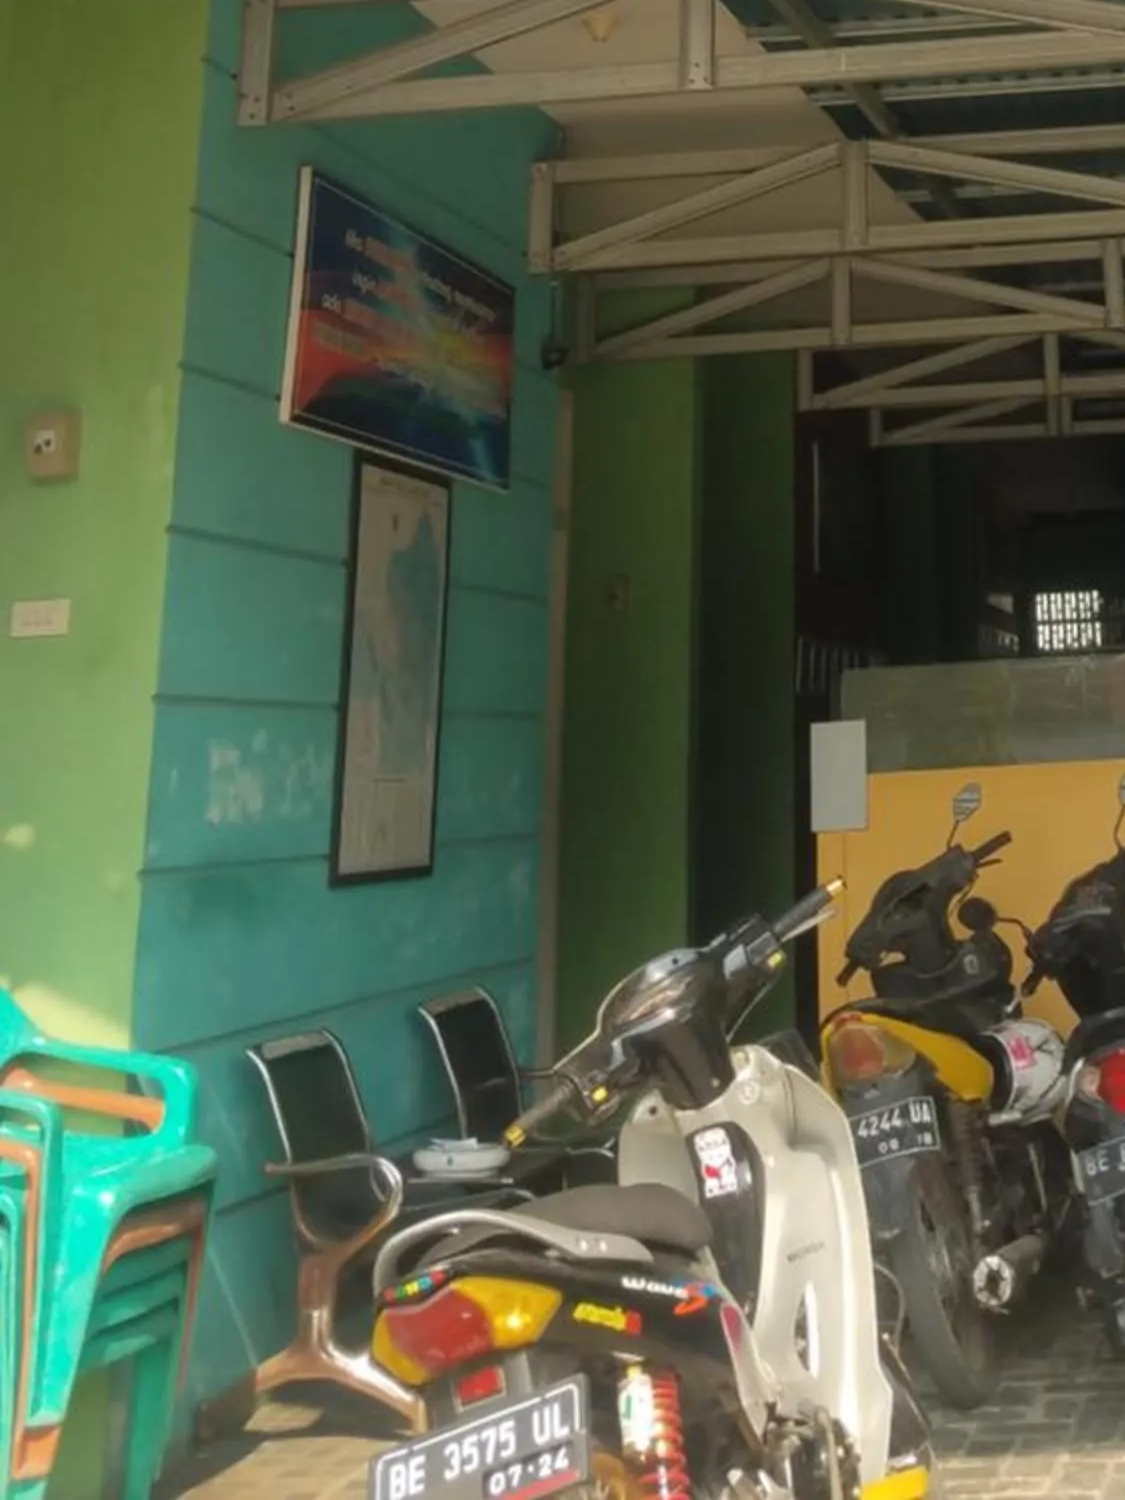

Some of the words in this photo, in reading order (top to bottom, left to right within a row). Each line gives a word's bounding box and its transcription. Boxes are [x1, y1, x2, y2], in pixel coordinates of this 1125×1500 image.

[388, 1454, 427, 1500] BE
[443, 1419, 517, 1481] 3575
[531, 1402, 571, 1445] UL
